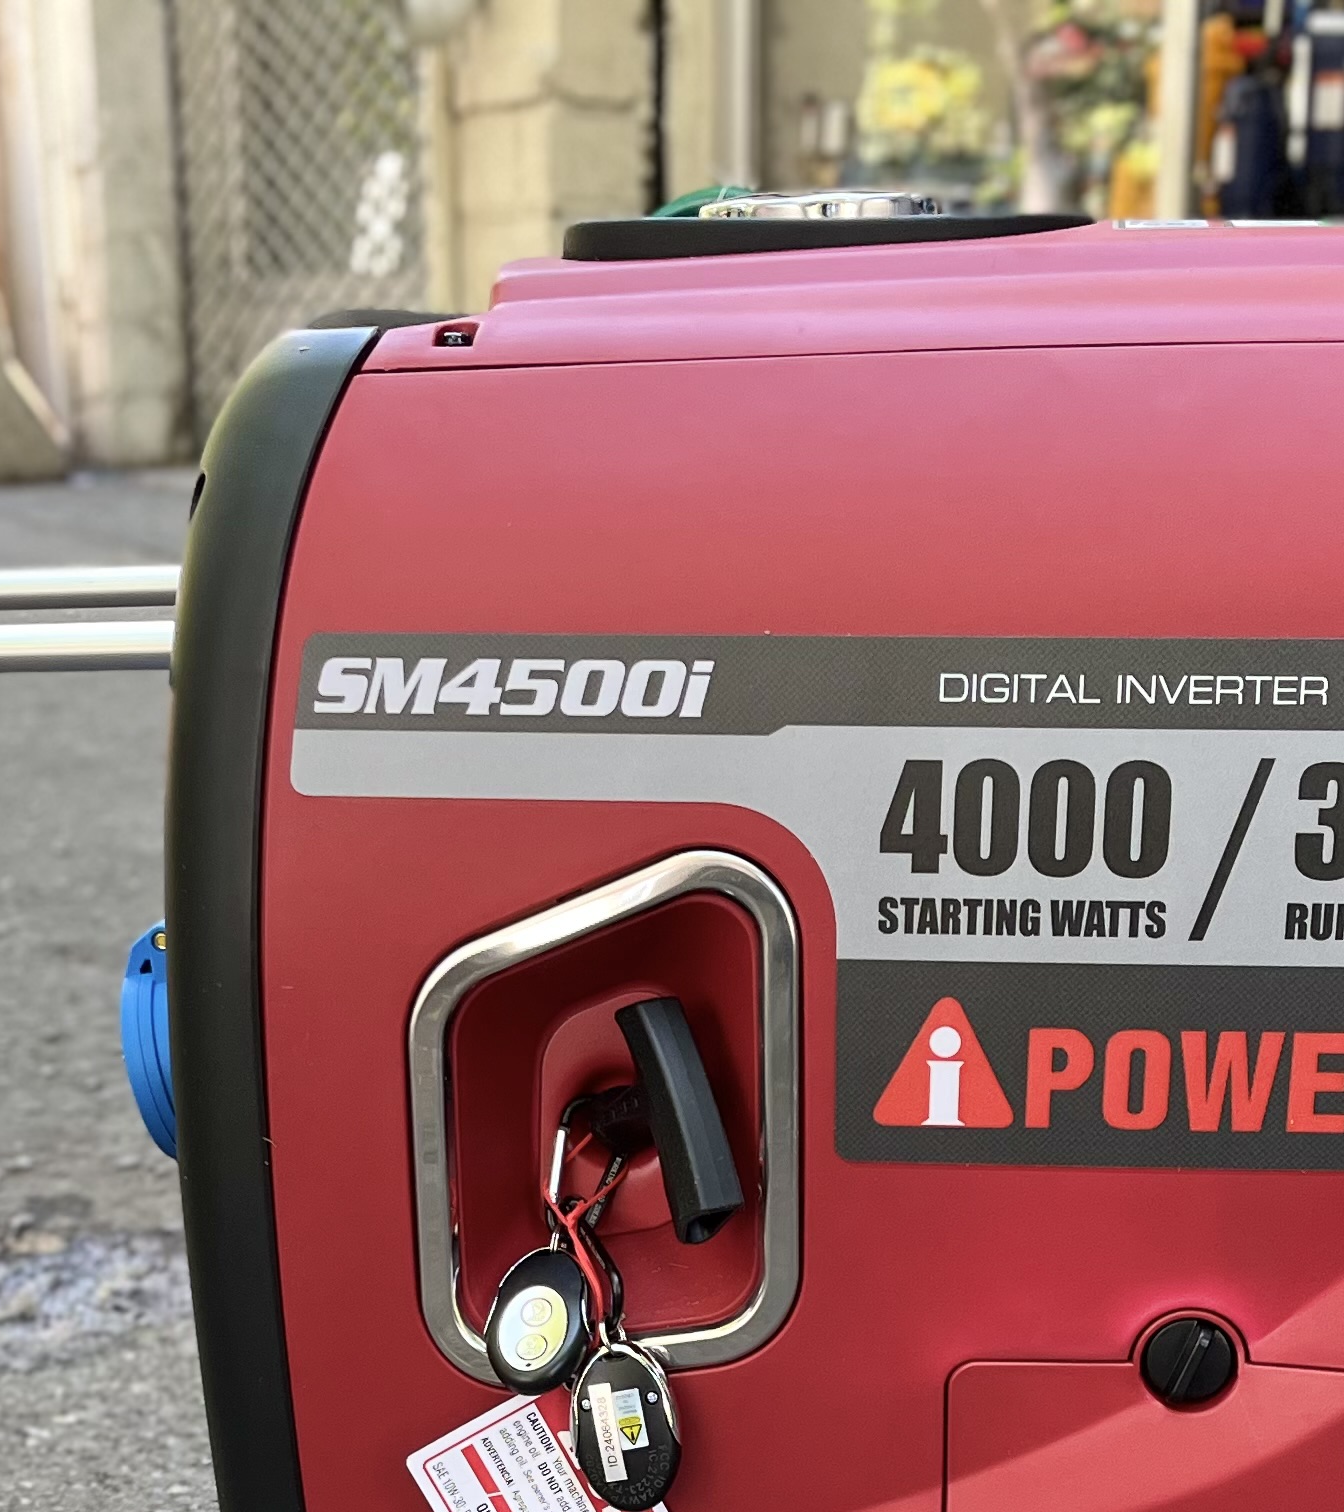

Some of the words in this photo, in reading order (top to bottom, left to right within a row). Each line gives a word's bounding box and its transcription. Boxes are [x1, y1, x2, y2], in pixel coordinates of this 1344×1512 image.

[313, 656, 715, 718] SM4500i
[938, 672, 1100, 705] DIGITAL
[1115, 673, 1329, 707] INVERTER
[879, 757, 1172, 879] 4000
[877, 896, 1041, 937] STARTING
[1049, 898, 1167, 940] WATTS
[497, 1426, 520, 1456] adding
[510, 1419, 533, 1448] engine
[537, 1461, 551, 1477] DO
[545, 1475, 563, 1496] NOT
[556, 1494, 572, 1512] add
[525, 1410, 556, 1454] CAUTION!
[551, 1457, 568, 1477] Your
[431, 1460, 449, 1480] SAE
